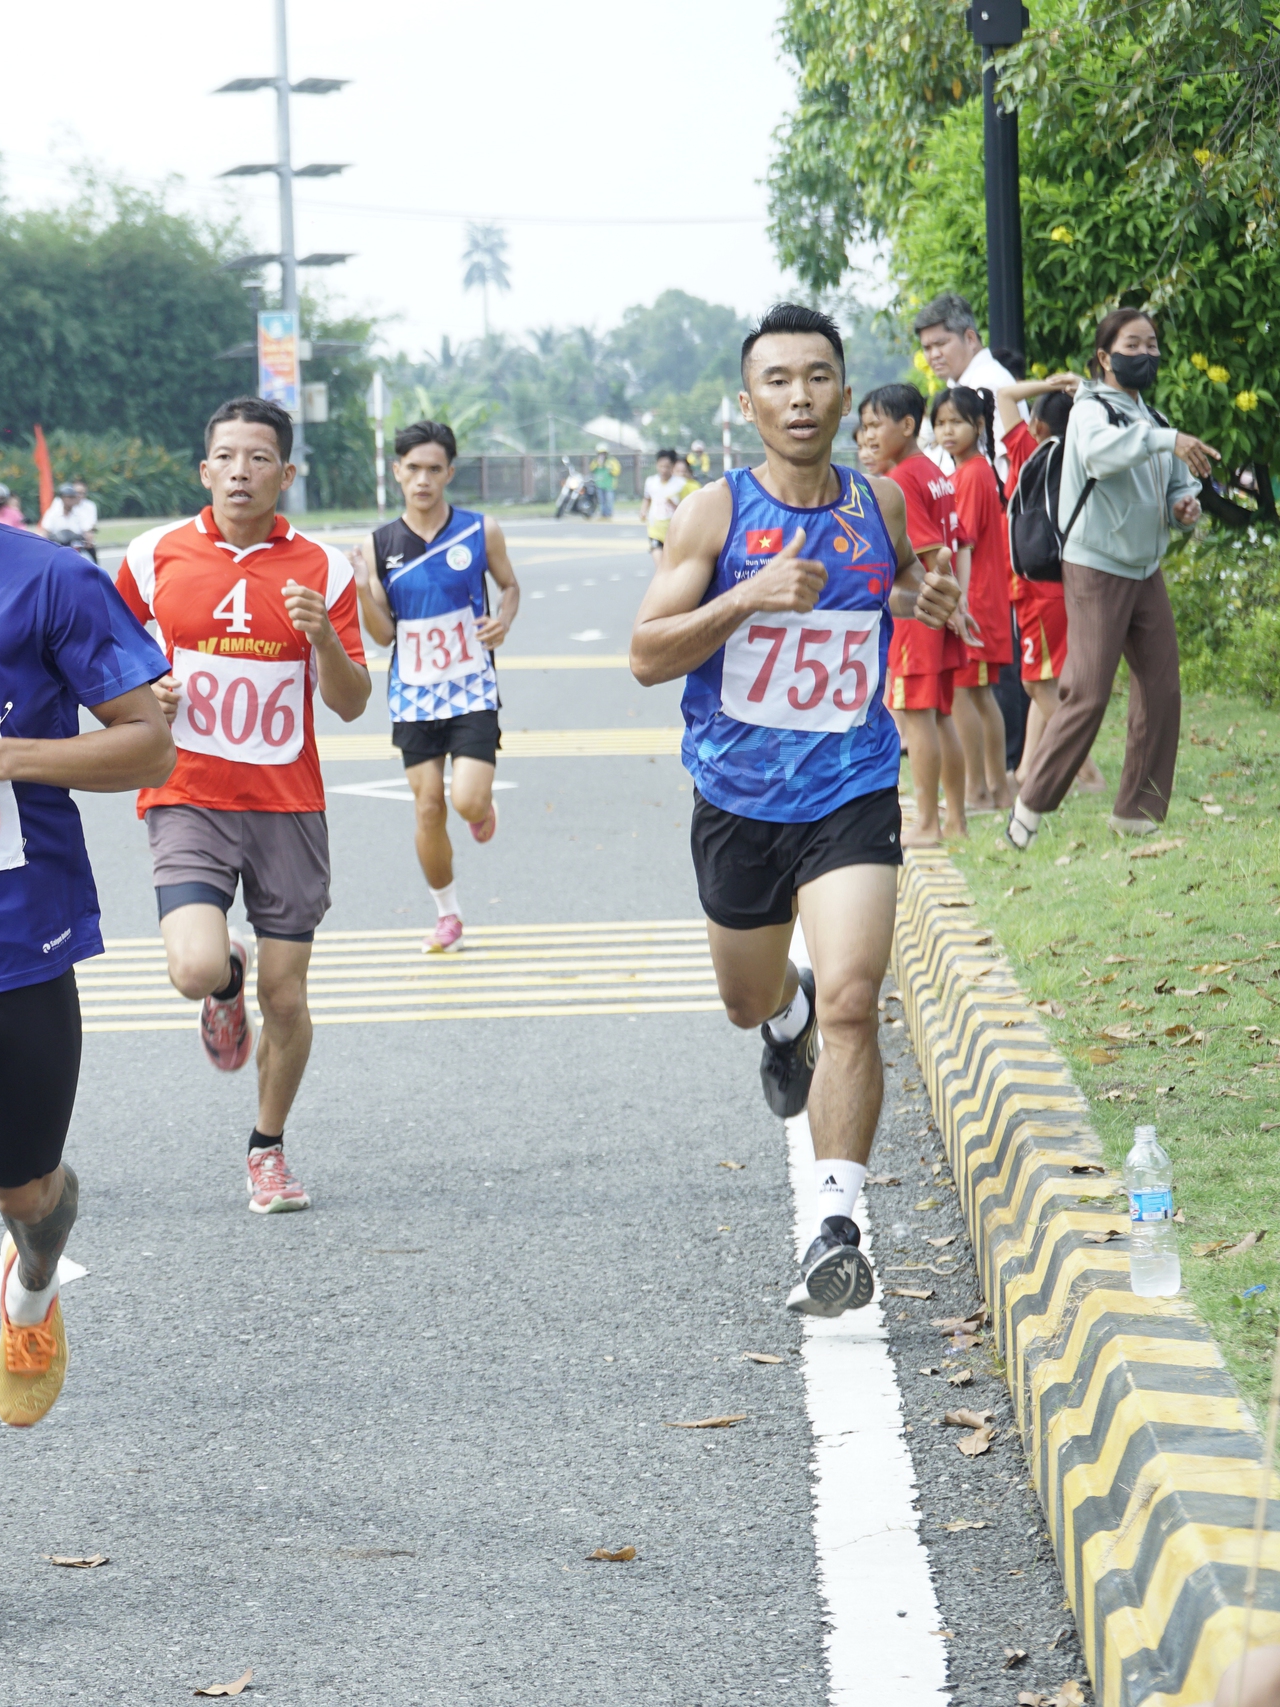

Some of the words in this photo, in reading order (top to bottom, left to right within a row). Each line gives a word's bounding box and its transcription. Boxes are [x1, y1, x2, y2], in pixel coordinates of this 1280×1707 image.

[212, 578, 253, 634] 4
[406, 621, 474, 673] 731
[746, 625, 871, 711] 755
[1023, 637, 1035, 664] 2
[187, 671, 295, 747] 806
